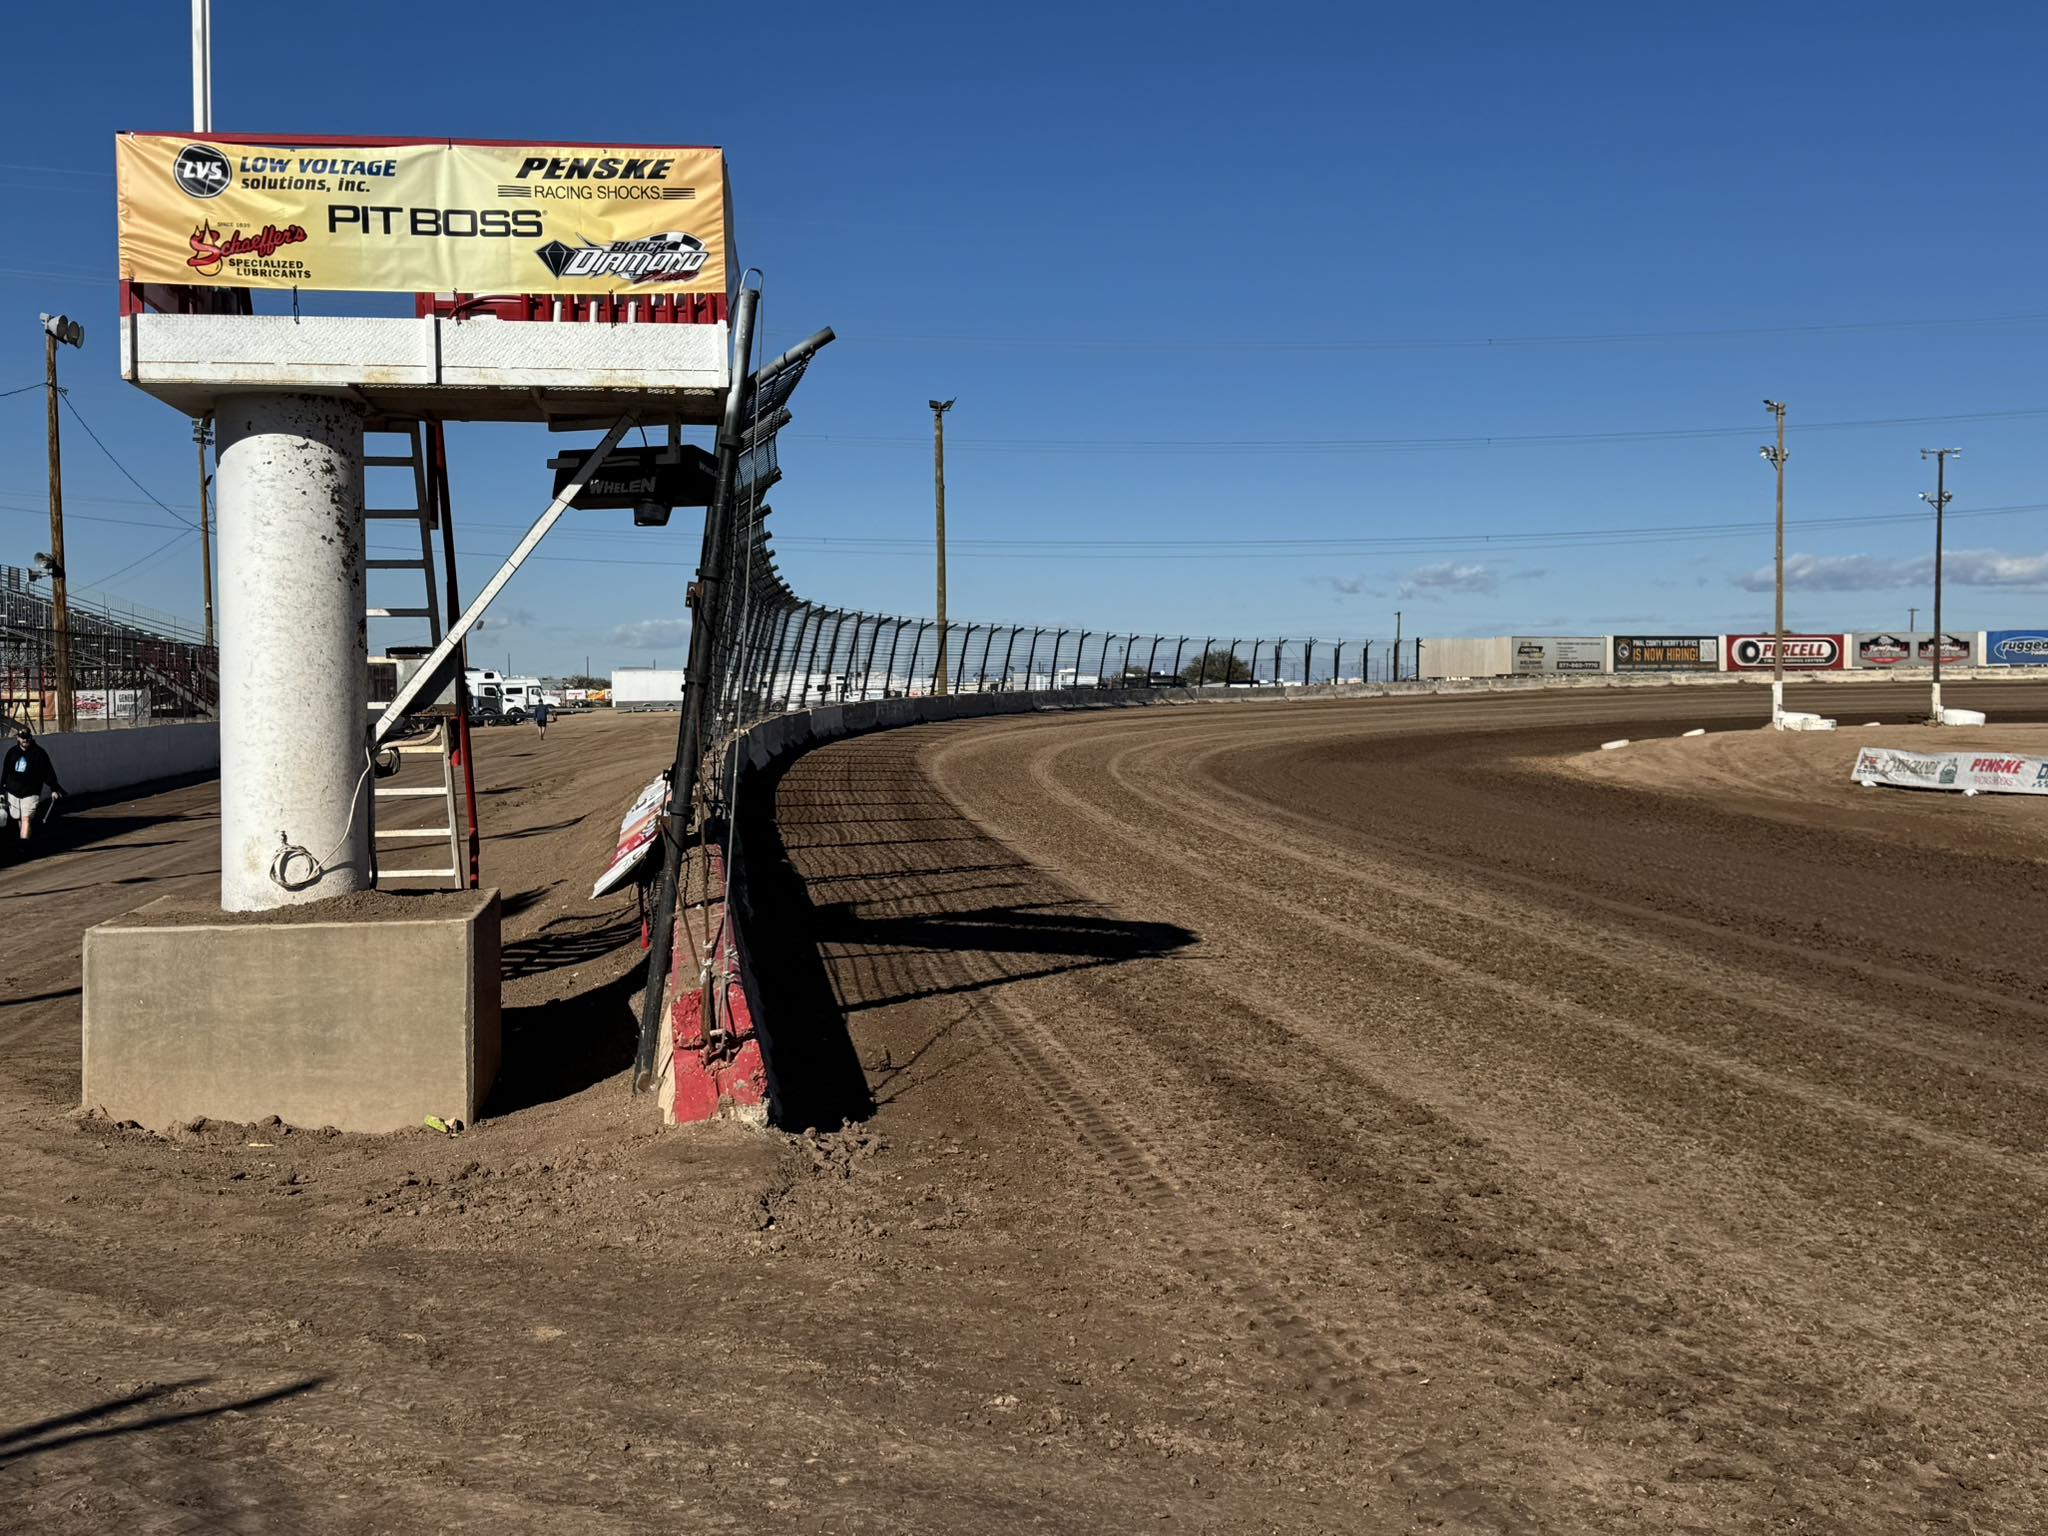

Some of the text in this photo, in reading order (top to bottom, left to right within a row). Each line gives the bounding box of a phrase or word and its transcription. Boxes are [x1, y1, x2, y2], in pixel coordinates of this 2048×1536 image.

[182, 160, 223, 180] LVS
[240, 156, 397, 177] LOW VOLTAGE
[516, 157, 675, 180] PENSKE
[241, 175, 371, 193] solutions, inc.
[534, 185, 593, 200] RACING
[328, 204, 543, 238] PIT BOSS
[186, 222, 308, 267] Schaeffer's
[610, 241, 671, 252] BLACK
[229, 258, 304, 269] SPECIALIZED
[564, 250, 709, 276] DIAMOND
[237, 268, 312, 279] LUBRICANTS
[589, 477, 656, 494] WHELEN
[1633, 647, 1698, 661] IS NOW HIRING!
[1969, 758, 2026, 775] PENSKE
